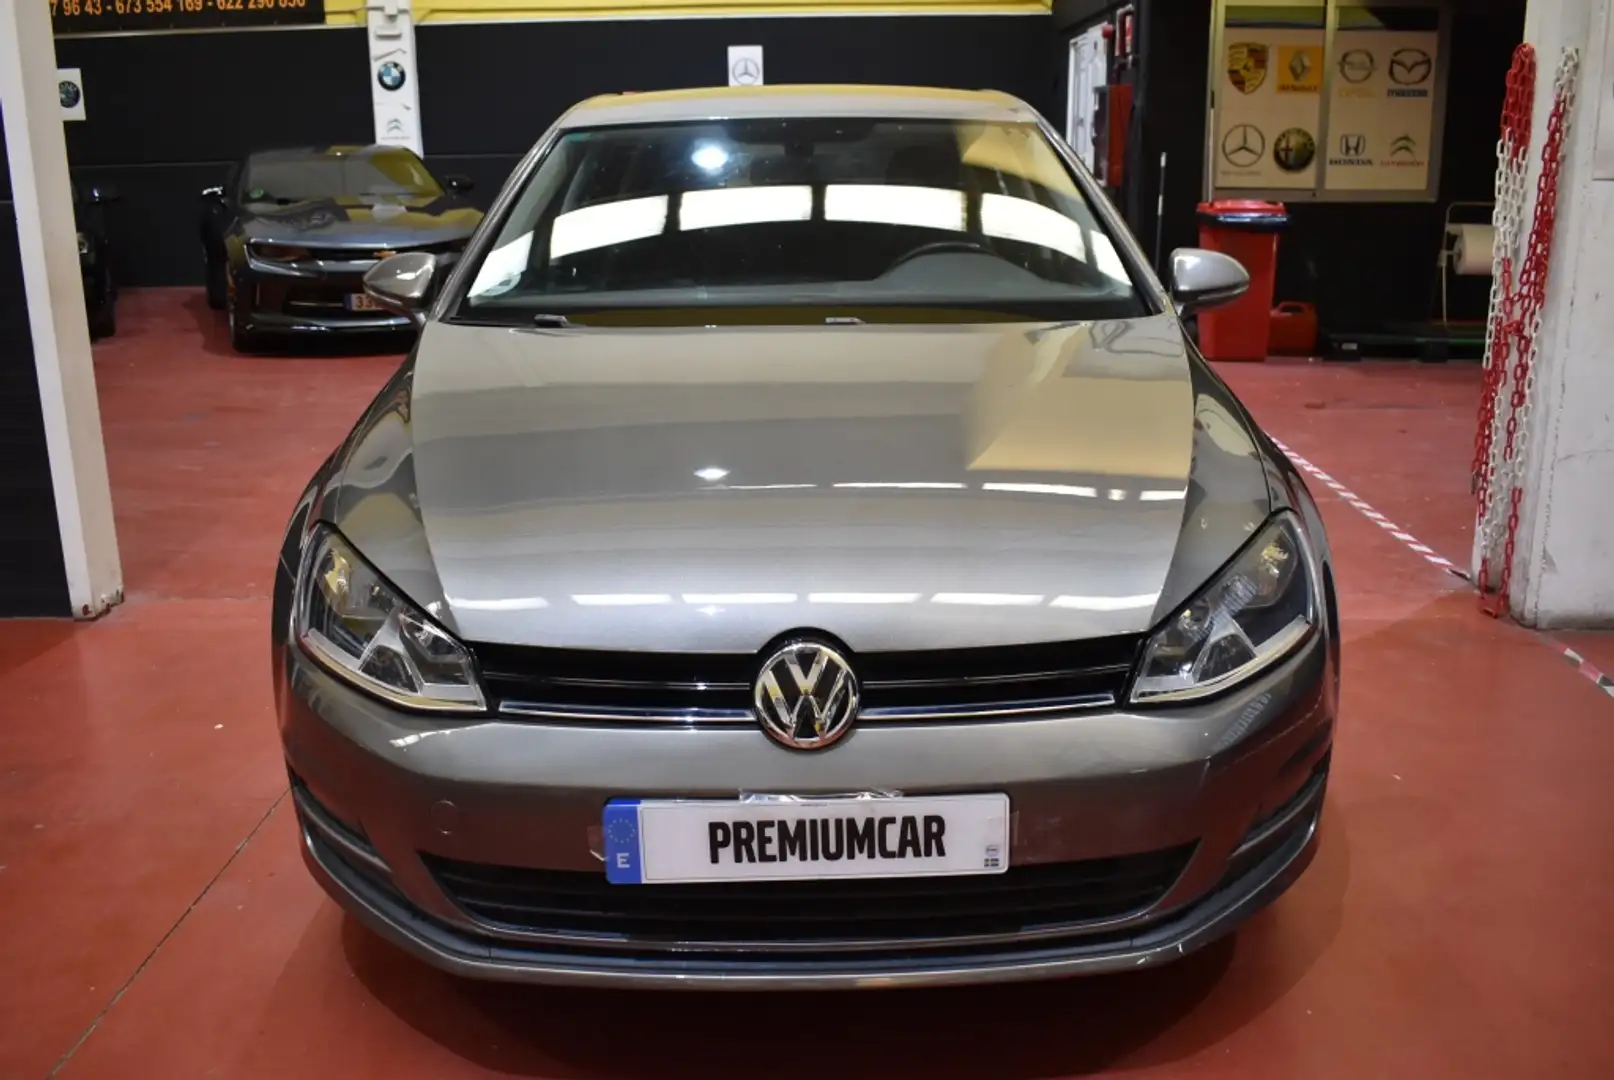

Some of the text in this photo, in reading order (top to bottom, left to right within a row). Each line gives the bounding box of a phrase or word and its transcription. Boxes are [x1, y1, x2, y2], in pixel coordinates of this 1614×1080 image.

[84, 0, 102, 15] 43
[116, 0, 142, 14] 673
[708, 815, 946, 864] PREMIUMCAR
[616, 852, 630, 868] E
